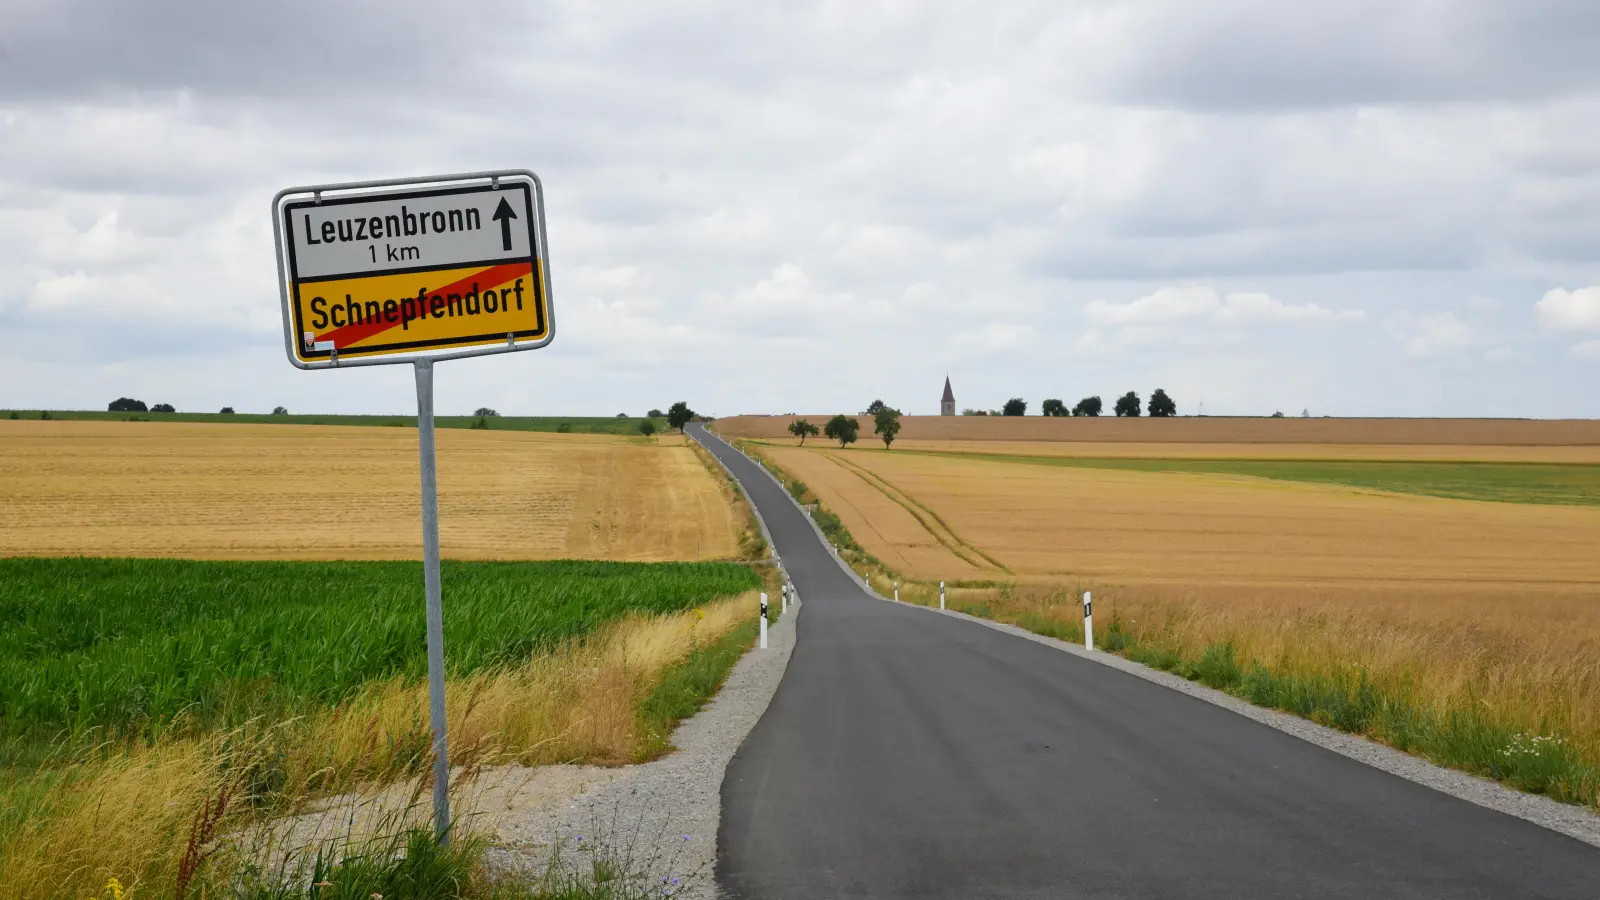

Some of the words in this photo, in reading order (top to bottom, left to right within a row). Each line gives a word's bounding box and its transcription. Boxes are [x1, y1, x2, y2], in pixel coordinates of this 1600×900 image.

[305, 206, 481, 245] Leuzenbronn
[368, 245, 377, 263] 1
[387, 244, 420, 262] km
[311, 279, 524, 330] Schnepfendorf
